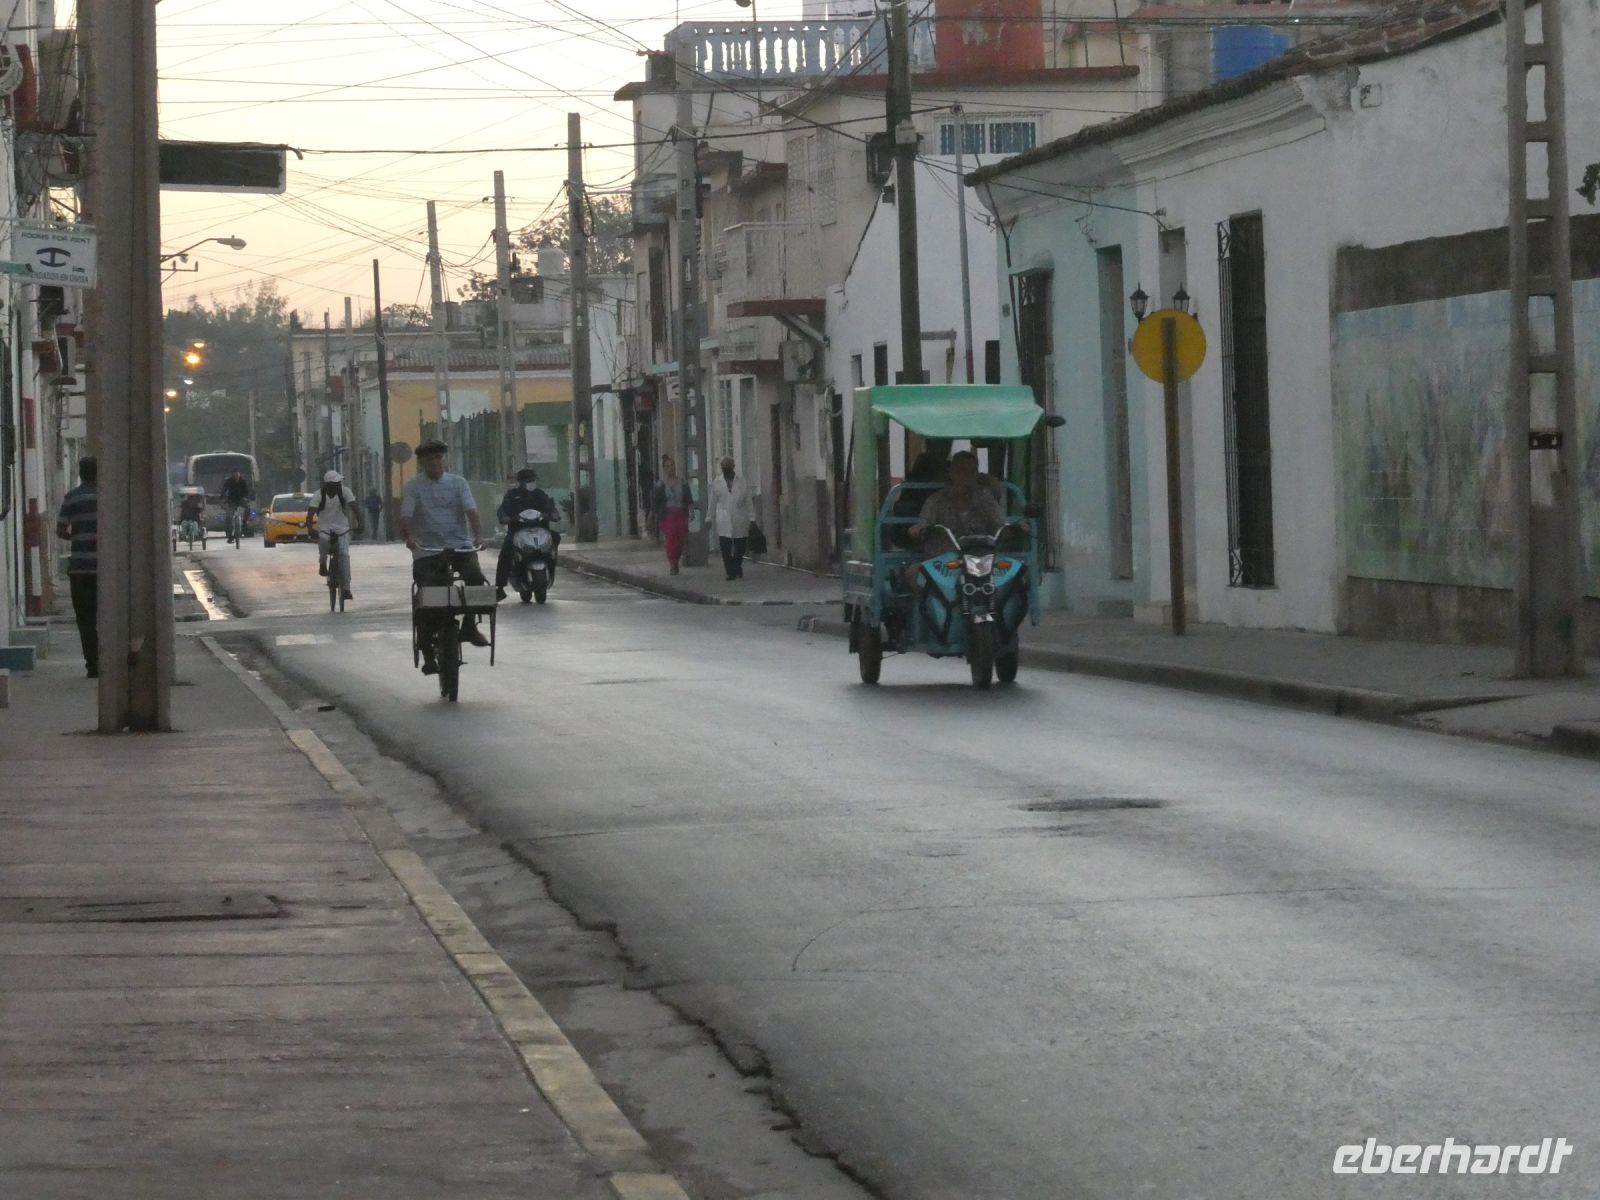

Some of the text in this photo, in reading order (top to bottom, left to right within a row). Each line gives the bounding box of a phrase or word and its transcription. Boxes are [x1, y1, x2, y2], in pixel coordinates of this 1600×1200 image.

[21, 231, 92, 245] ROOMS FOR RENT
